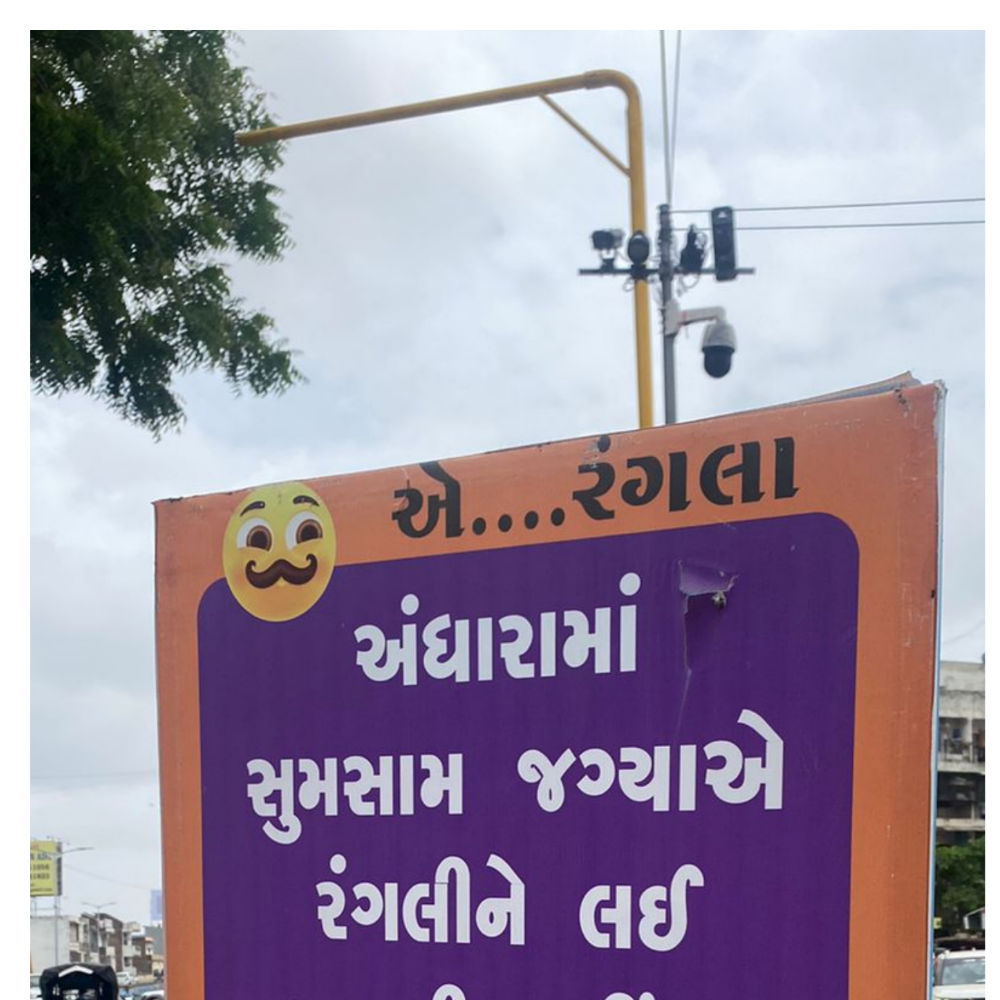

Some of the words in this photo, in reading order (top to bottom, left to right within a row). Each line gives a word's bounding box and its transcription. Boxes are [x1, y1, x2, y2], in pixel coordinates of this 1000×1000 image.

[355, 572, 641, 686] અંધારામાં
[247, 753, 463, 845] સુમસામ
[517, 708, 784, 812] જગ્યાએ
[316, 853, 526, 946] રંગલીને
[579, 863, 704, 952] લઈ
